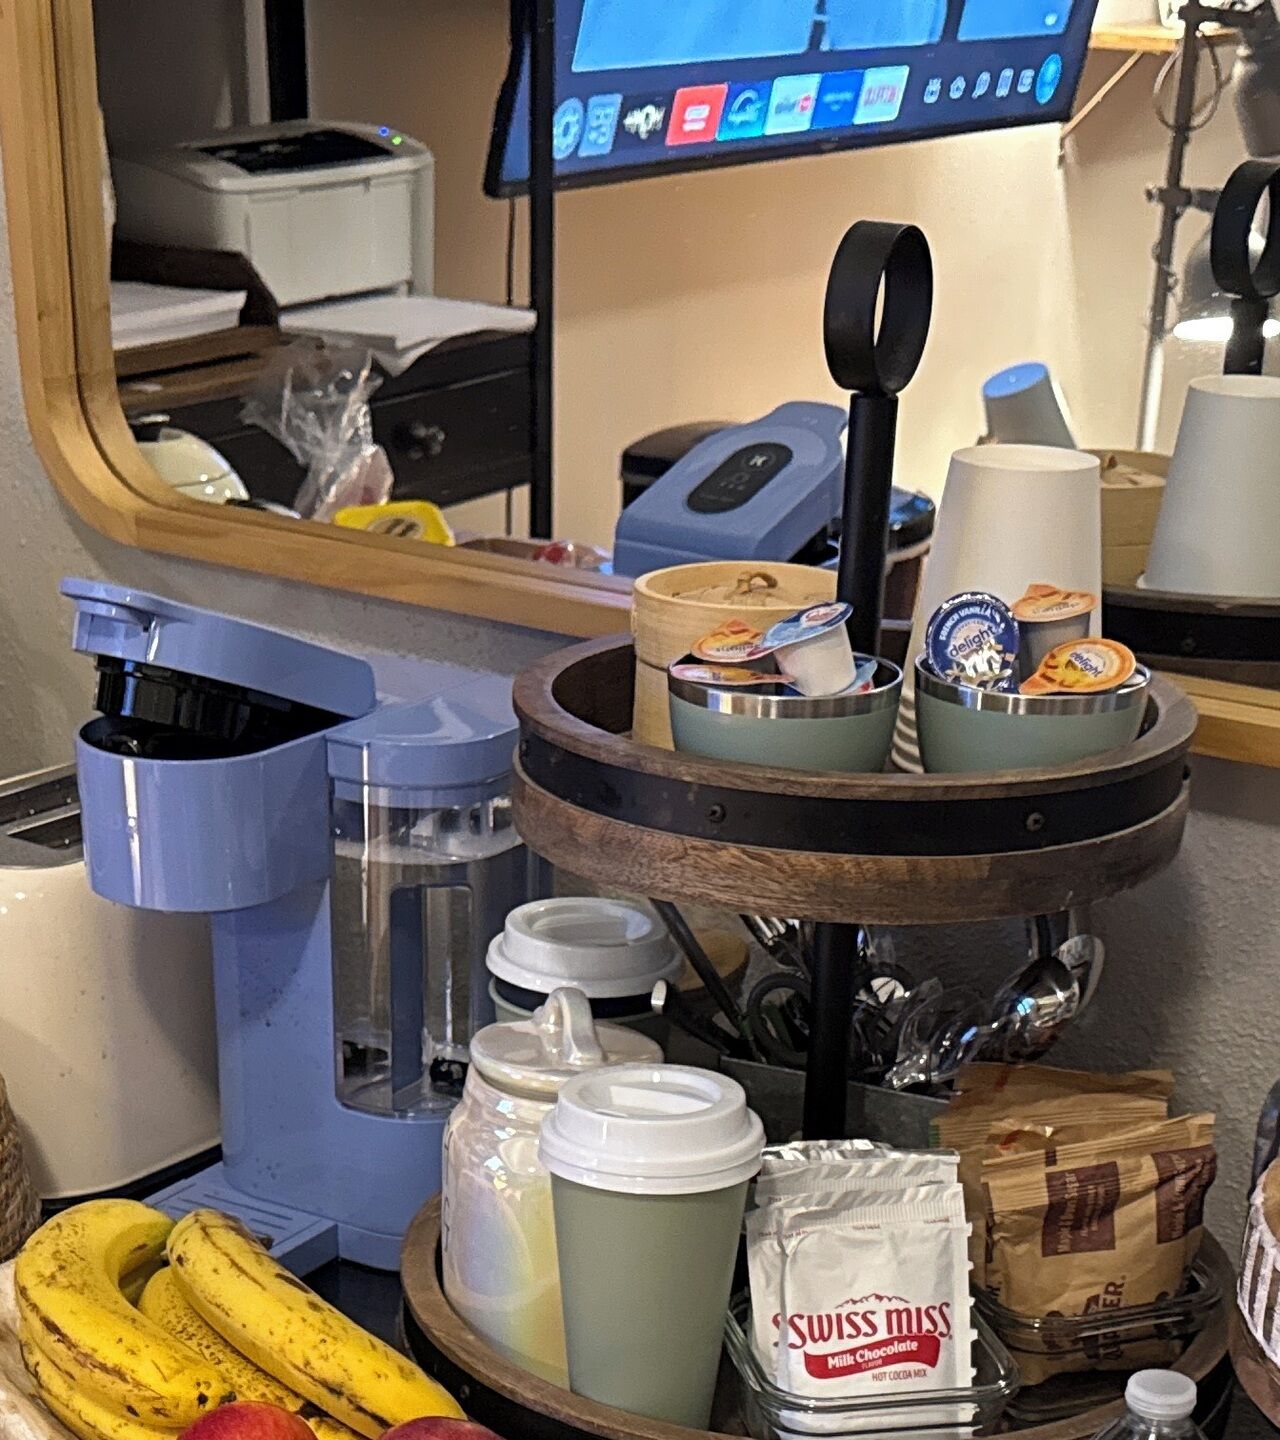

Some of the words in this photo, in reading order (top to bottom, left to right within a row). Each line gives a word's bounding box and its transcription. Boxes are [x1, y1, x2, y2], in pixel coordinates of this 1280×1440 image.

[949, 624, 996, 657] delight
[1070, 652, 1105, 678] delight
[787, 1310, 878, 1350] SWISS
[827, 1351, 856, 1370] Milk
[855, 1340, 919, 1363] Chocolate
[872, 1372, 888, 1382] HOT
[888, 1370, 913, 1381] COCOA
[913, 1368, 928, 1378] MIX
